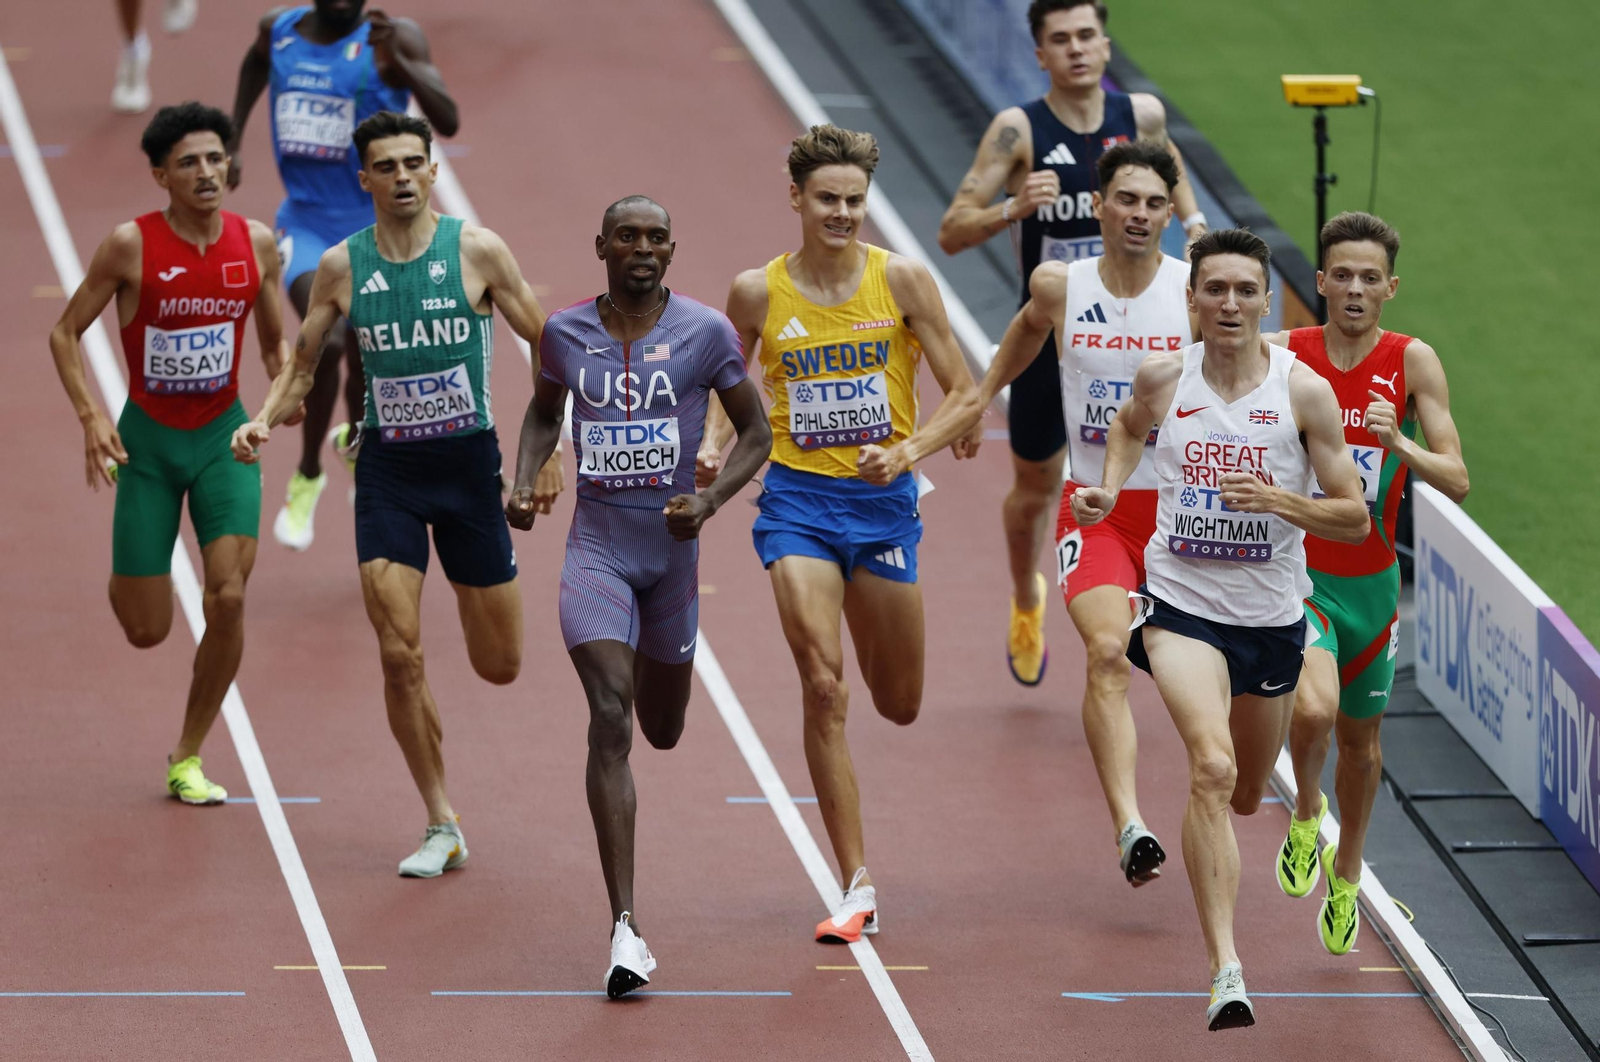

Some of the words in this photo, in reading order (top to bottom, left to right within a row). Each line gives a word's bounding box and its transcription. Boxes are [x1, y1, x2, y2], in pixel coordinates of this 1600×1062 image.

[294, 98, 345, 118] TDK
[1068, 241, 1104, 259] TD
[159, 297, 245, 318] MOROCCO
[422, 297, 457, 310] 123.ie
[853, 320, 895, 330] BAUHAUS
[168, 327, 227, 352] TDK
[1072, 333, 1181, 350] FRANCE
[150, 350, 229, 375] ESSAYI
[781, 340, 890, 378] SWEDEN
[396, 371, 463, 398] TDK
[578, 367, 677, 411] USA
[813, 376, 879, 402] TDK
[381, 392, 470, 423] COSCORAN
[795, 403, 886, 431] PIHLSTRÖM
[603, 422, 671, 445] TDK
[1203, 430, 1248, 444] Novuna
[587, 447, 674, 472] J.KOECH
[1185, 441, 1268, 468] GREAT
[1182, 465, 1274, 488] BRIN
[1175, 513, 1268, 542] WIGHTMAN
[1060, 539, 1079, 573] 12
[1430, 545, 1475, 714] TDK
[1487, 601, 1533, 721] Everything
[1477, 662, 1504, 744] Better
[1552, 667, 1596, 849] TDK
